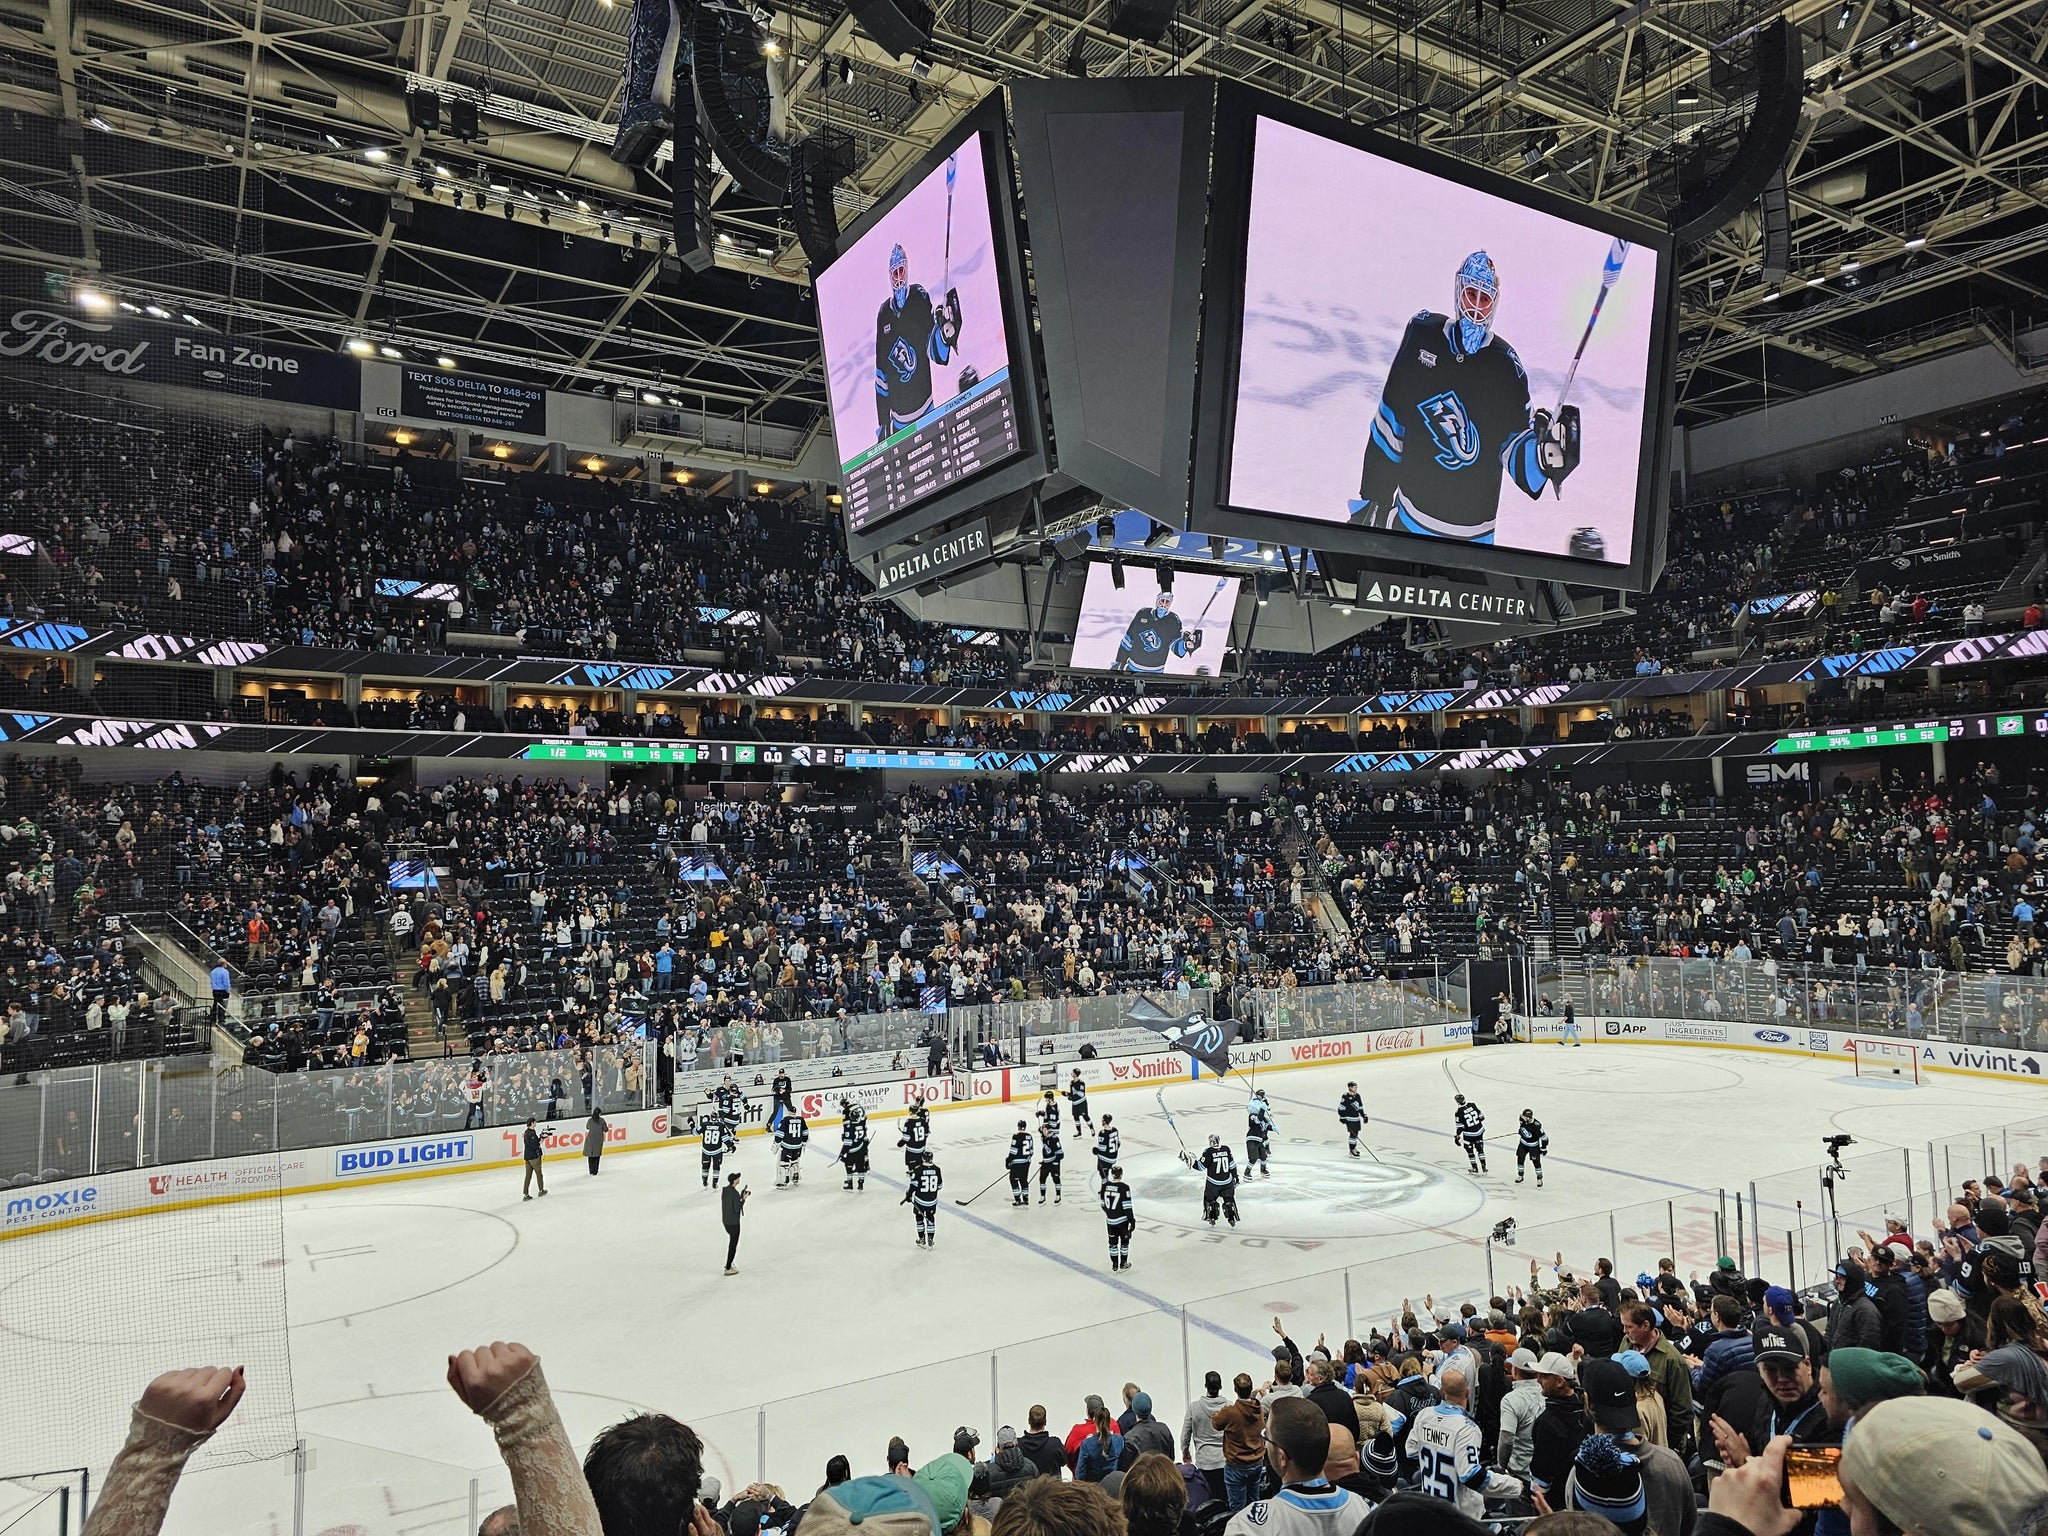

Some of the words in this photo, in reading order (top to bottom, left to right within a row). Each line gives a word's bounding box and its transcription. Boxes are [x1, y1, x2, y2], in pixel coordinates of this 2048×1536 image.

[0, 309, 151, 375] Ford
[175, 337, 225, 363] Fan
[232, 347, 299, 374] Zone
[408, 371, 433, 383] TEXT
[435, 376, 455, 386] SOS
[457, 379, 487, 392] DELTA
[488, 384, 501, 393] TO
[503, 387, 541, 400] 848-261
[419, 385, 443, 393] Provides
[444, 388, 464, 396] instant
[465, 391, 488, 400] two-way
[501, 398, 530, 408] messaging
[455, 399, 480, 408] improved
[482, 403, 516, 413] management
[500, 411, 522, 419] services
[889, 554, 930, 584] DELTA
[933, 530, 984, 565] CENTER
[1933, 550, 1961, 561] Smith's
[1389, 584, 1452, 608] DELTA
[1459, 592, 1525, 616] CENTER
[1796, 740, 1811, 749] 1/2
[1829, 736, 1850, 747] 34%
[1866, 734, 1878, 744] 19
[1894, 732, 1907, 742] 15
[1920, 730, 1935, 740] 52
[1949, 726, 1964, 737] 27
[1977, 719, 1987, 736] 1
[550, 748, 566, 757] 1/2
[586, 749, 607, 759] 34%
[622, 750, 634, 759] 19
[650, 751, 660, 759] 15
[672, 751, 685, 760] 52
[697, 750, 710, 760] 27
[720, 746, 728, 761] 1
[763, 751, 783, 763] 0.0
[816, 749, 826, 763] 2
[833, 754, 844, 763] 27
[658, 826, 668, 835] 92
[396, 917, 407, 927] 92
[1444, 1025, 1473, 1039] Layton
[1669, 1027, 1724, 1036] INGREDIENTS
[1760, 1031, 1785, 1042] Ford
[1291, 1038, 1352, 1061] verizon
[1865, 1041, 1936, 1060] DELA
[1132, 1055, 1183, 1079] Smith's
[1949, 1047, 2018, 1073] vivint
[824, 1091, 856, 1102] CRAIG
[858, 1087, 890, 1099] SWAPP
[1464, 1110, 1480, 1128] 22
[704, 1130, 720, 1145] 88
[788, 1124, 801, 1138] 41
[913, 1126, 925, 1142] 19
[341, 1149, 394, 1172] BUD
[398, 1140, 469, 1164] LIGHT
[1213, 1156, 1229, 1174] 70
[176, 1171, 228, 1187] HEALTH
[235, 1165, 278, 1177] OFFICIAL
[280, 1161, 305, 1171] CARE
[235, 1172, 282, 1185] PROVIDER
[920, 1175, 939, 1193] 38
[7, 1187, 98, 1216] moxie
[1104, 1191, 1121, 1210] 67
[6, 1213, 35, 1225] PEST
[42, 1204, 97, 1219] CONTROL
[1961, 1261, 1973, 1278] 9
[1761, 1333, 1787, 1348] WINE
[1422, 1427, 1450, 1448] TENNEY
[1420, 1446, 1455, 1504] 25
